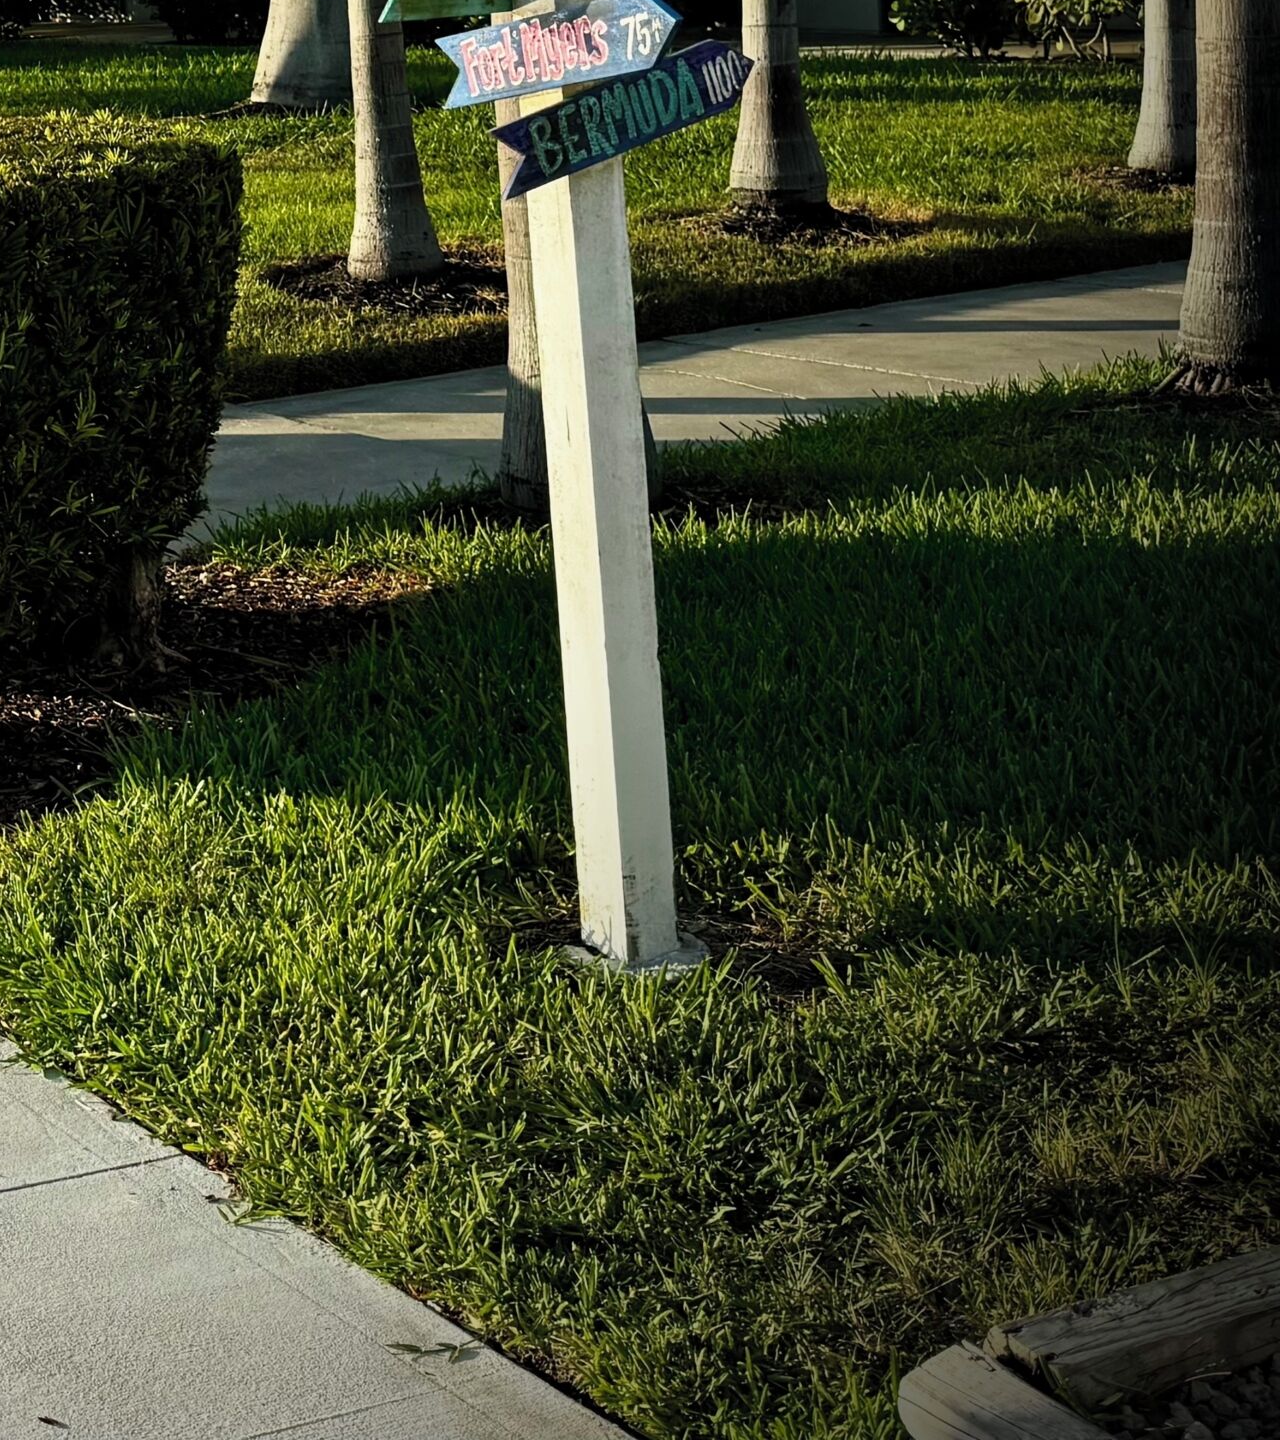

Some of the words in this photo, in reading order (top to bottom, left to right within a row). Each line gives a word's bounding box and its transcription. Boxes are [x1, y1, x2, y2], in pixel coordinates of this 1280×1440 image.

[459, 25, 525, 98] Fort
[519, 14, 610, 83] Myers
[527, 56, 705, 178] BERMUDA
